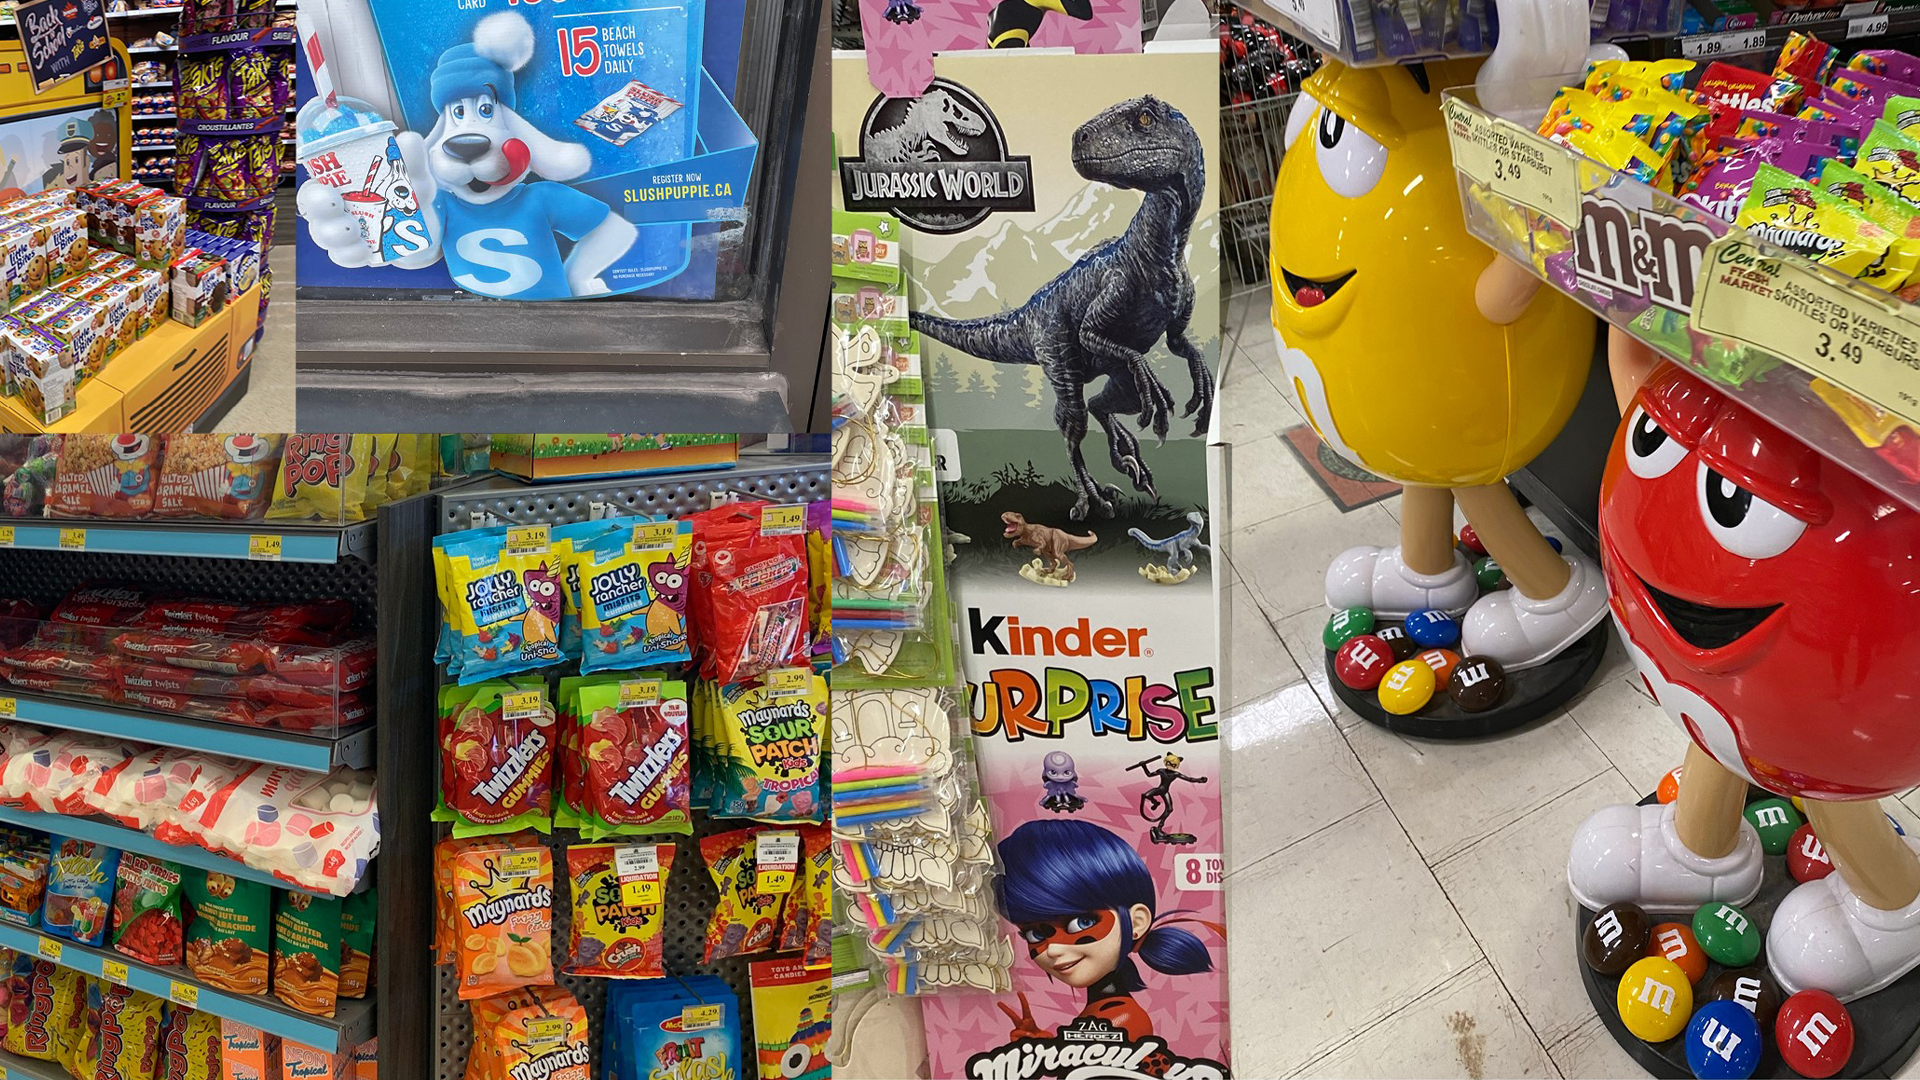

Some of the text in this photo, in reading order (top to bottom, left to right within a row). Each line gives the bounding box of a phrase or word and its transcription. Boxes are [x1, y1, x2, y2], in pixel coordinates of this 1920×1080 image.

[458, 0, 486, 10] CARD
[211, 32, 249, 45] FLAVOUR
[602, 26, 636, 42] BEACH
[1866, 21, 1887, 34] 4.99
[557, 26, 601, 77] 15
[603, 41, 644, 58] TOWELS
[1697, 36, 1765, 55] 1.89 1.89
[50, 55, 71, 73] WITH
[604, 59, 634, 74] DAILY
[197, 123, 254, 131] CROUSTILLANTES
[1475, 124, 1545, 162] ASSORTED VARIETIES
[1471, 132, 1553, 177] SKITTLES OR STARBURST
[652, 173, 702, 184] REGISTER NOW
[1494, 159, 1521, 182] 3.49
[623, 183, 732, 203] SLUSHPUPPIE.CA
[852, 168, 1024, 201] JURASSIC WORLD
[53, 227, 71, 246] Little
[60, 233, 78, 250] Bites
[10, 244, 28, 266] Little
[17, 250, 36, 270] Bites
[454, 228, 543, 297] S
[1719, 274, 1774, 299] MARKET
[1729, 265, 1770, 286] FRESH
[1783, 281, 1919, 353] ASSORTED VARIETIES
[1774, 289, 1920, 371] SKITTLES OR STARBURS
[1814, 332, 1864, 365] 3.49
[284, 433, 350, 465] Ring
[58, 473, 86, 483] SALTED
[161, 473, 190, 484] SALTED
[284, 452, 355, 498] POP
[55, 482, 92, 495] CARAMEL
[467, 571, 516, 601] JOLLY
[590, 565, 637, 596] JOLLY
[472, 584, 521, 608] rancher
[595, 580, 644, 604] rancher
[603, 593, 642, 612] MISFITS
[124, 675, 180, 691] Twizzlers twists
[153, 697, 177, 710] twists
[749, 719, 813, 744] SOUR
[750, 735, 819, 765] PATCH
[470, 729, 548, 807] Twizzlers
[607, 727, 683, 807] Twizzlers
[783, 757, 808, 770] Kids
[501, 750, 551, 809] GUMMIES
[1754, 805, 1789, 828] m
[134, 854, 181, 884] RED BERRIES
[620, 873, 659, 883] LIQUIDATION
[1186, 858, 1201, 884] 8
[620, 916, 643, 927] Kids
[1594, 909, 1625, 947] m
[1714, 904, 1749, 935] m
[293, 924, 322, 939] BUTTER
[607, 944, 643, 965] Crush
[1657, 929, 1688, 961] m
[773, 971, 807, 980] CANDIES
[1637, 976, 1676, 1015] m
[223, 1034, 261, 1051] Tropical
[1700, 1016, 1742, 1062] m
[1796, 1011, 1839, 1057] m
[285, 1045, 327, 1067] NEON
[285, 1060, 330, 1079] Tropical
